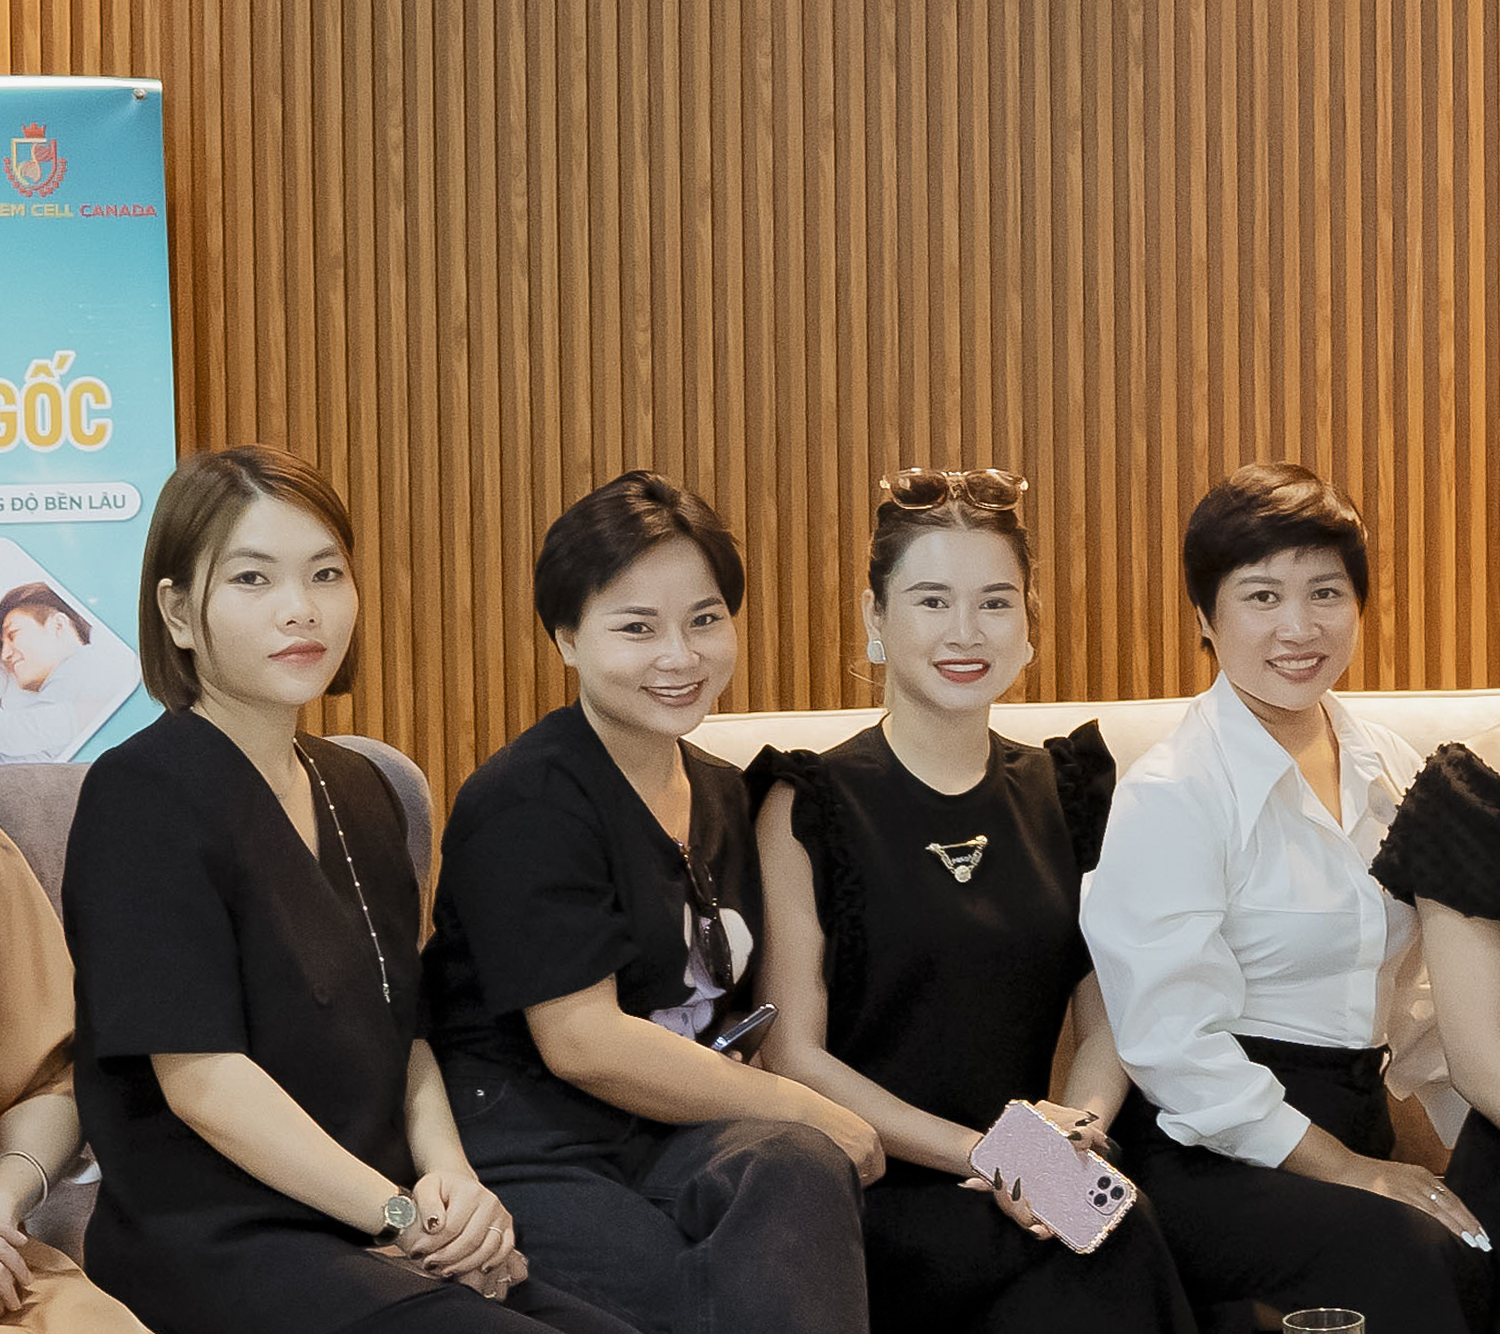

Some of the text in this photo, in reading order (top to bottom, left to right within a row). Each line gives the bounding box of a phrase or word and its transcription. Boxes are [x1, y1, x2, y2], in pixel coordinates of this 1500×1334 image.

[31, 203, 74, 217] CELL
[79, 204, 157, 218] CANADA
[10, 493, 39, 514] ĐỘ
[44, 490, 83, 511] BỀN
